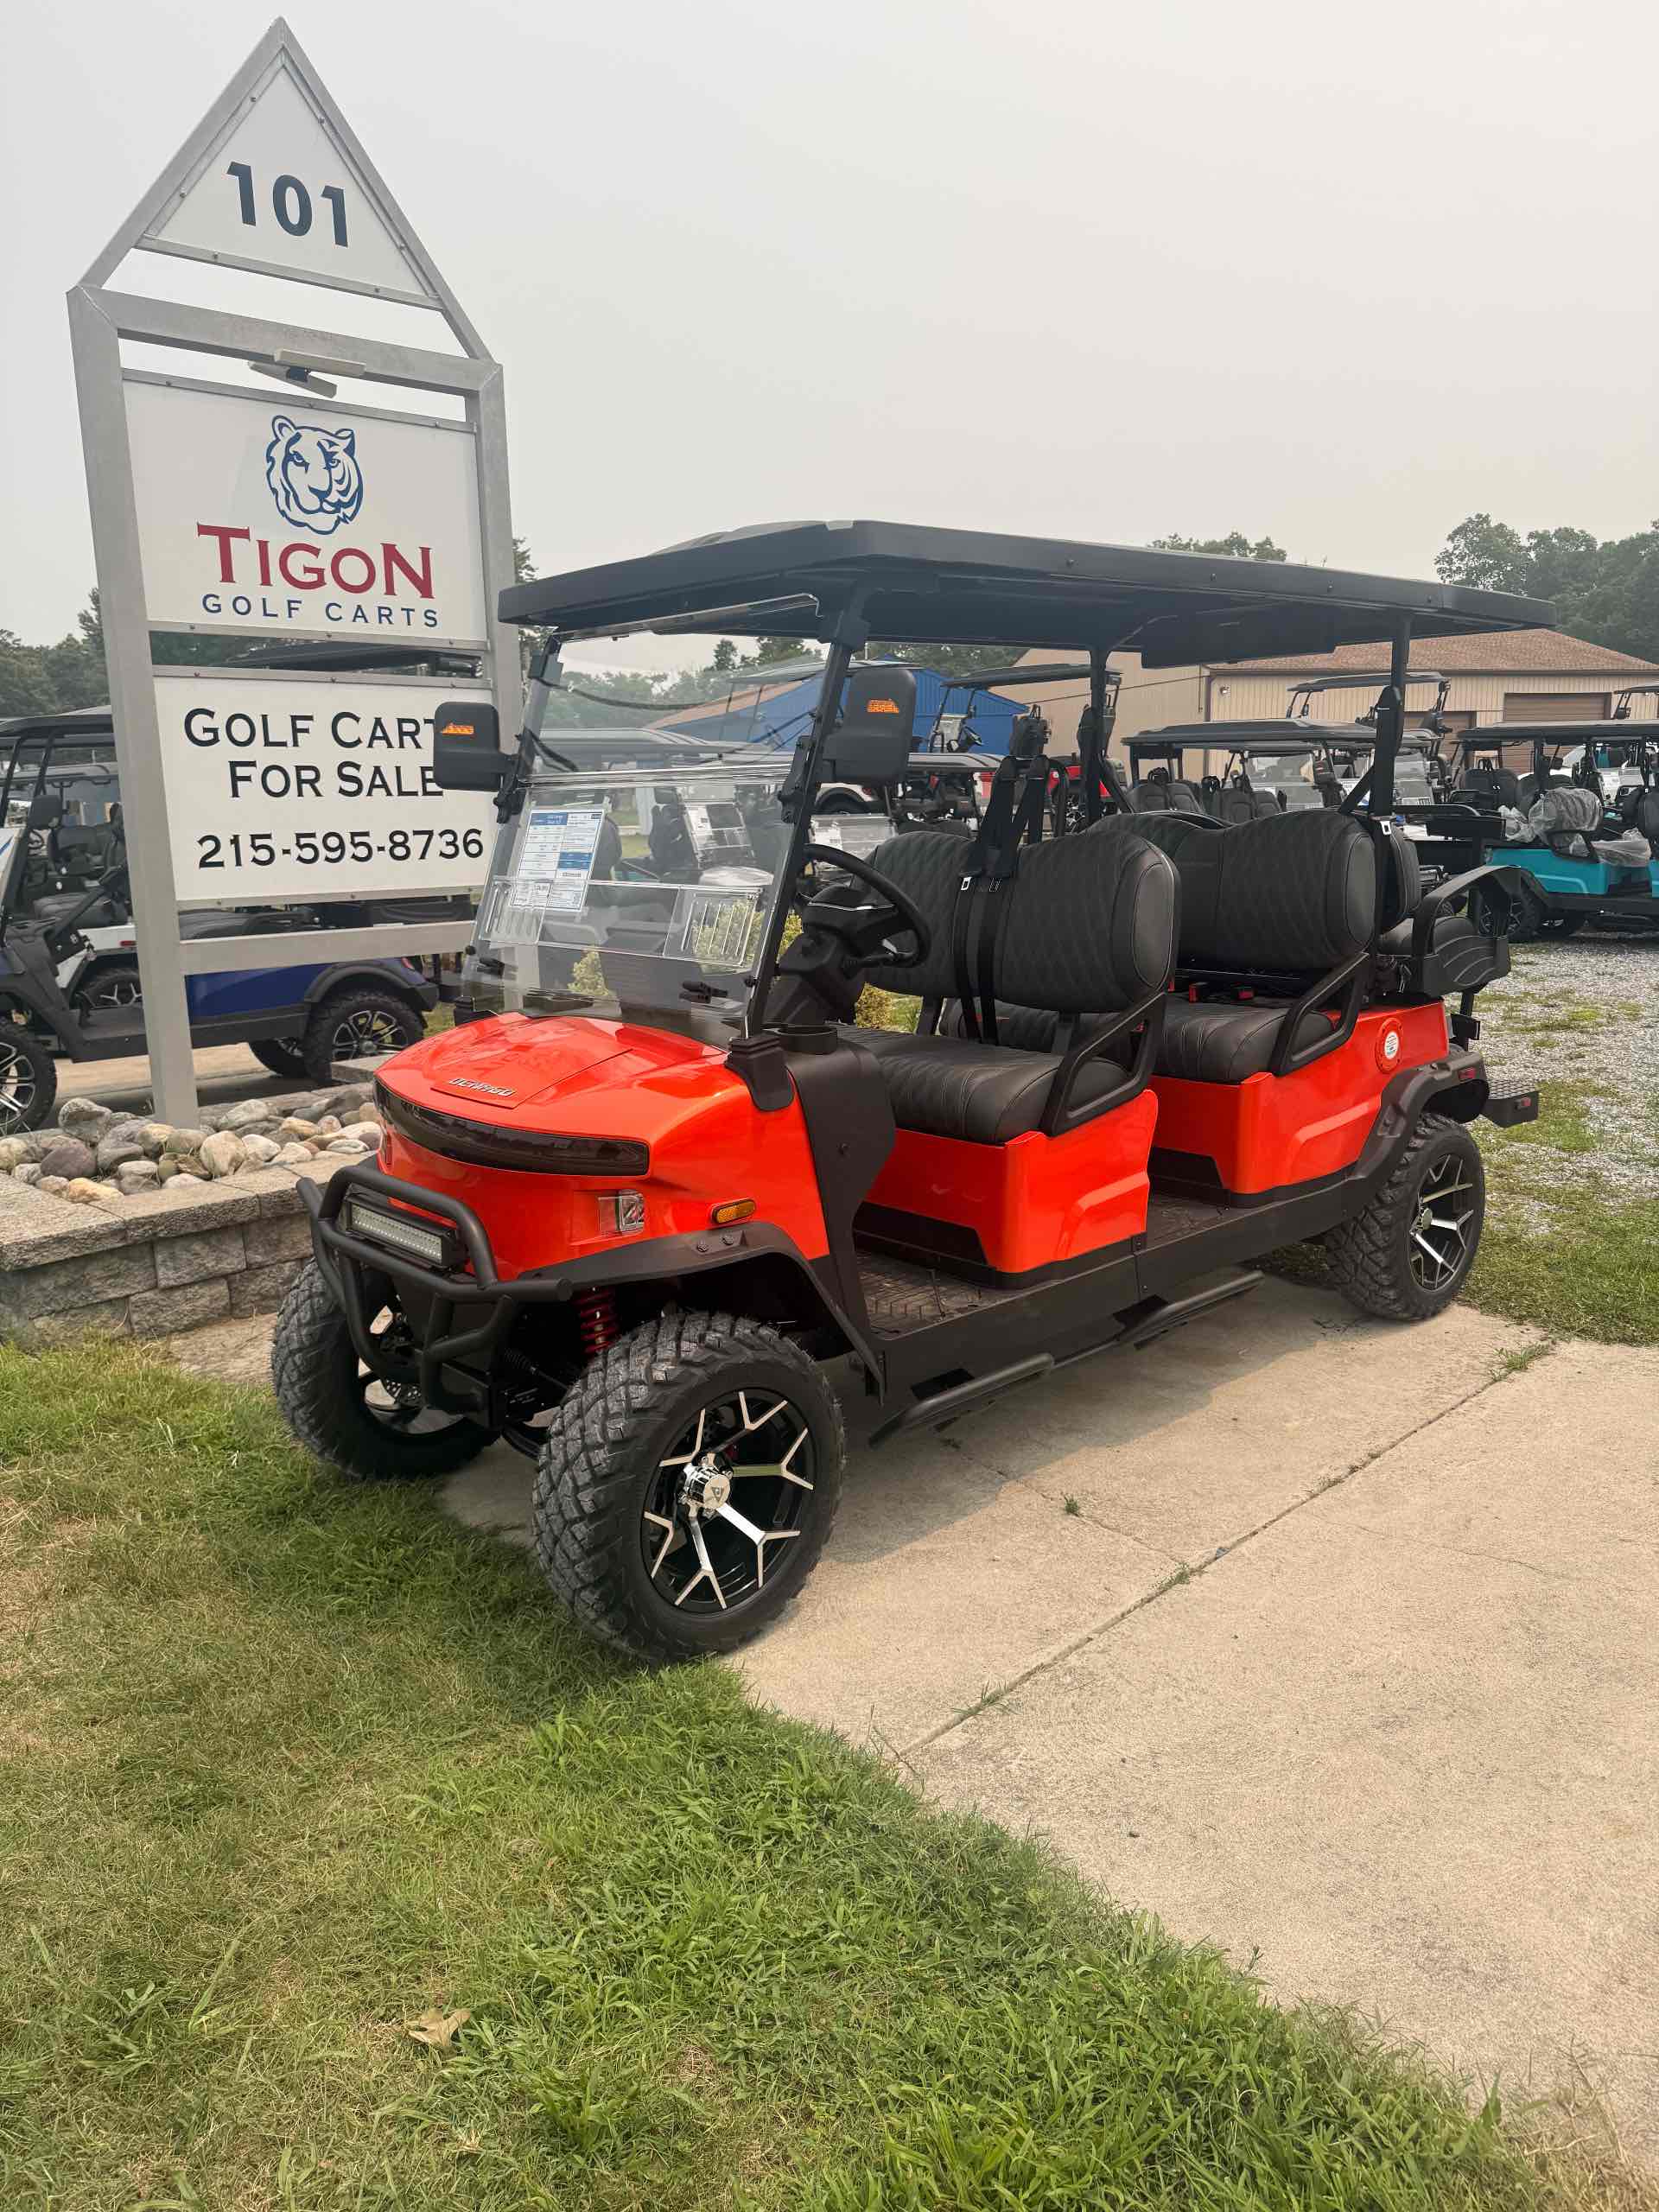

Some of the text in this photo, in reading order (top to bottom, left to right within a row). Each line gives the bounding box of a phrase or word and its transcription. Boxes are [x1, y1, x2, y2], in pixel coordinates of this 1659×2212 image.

[226, 161, 348, 248] 101
[197, 524, 435, 599] TIGON
[201, 594, 438, 628] GOLF CARTS
[183, 708, 314, 748] GOLF
[228, 760, 443, 798] FOR SALE
[197, 828, 484, 869] 215-595-8736
